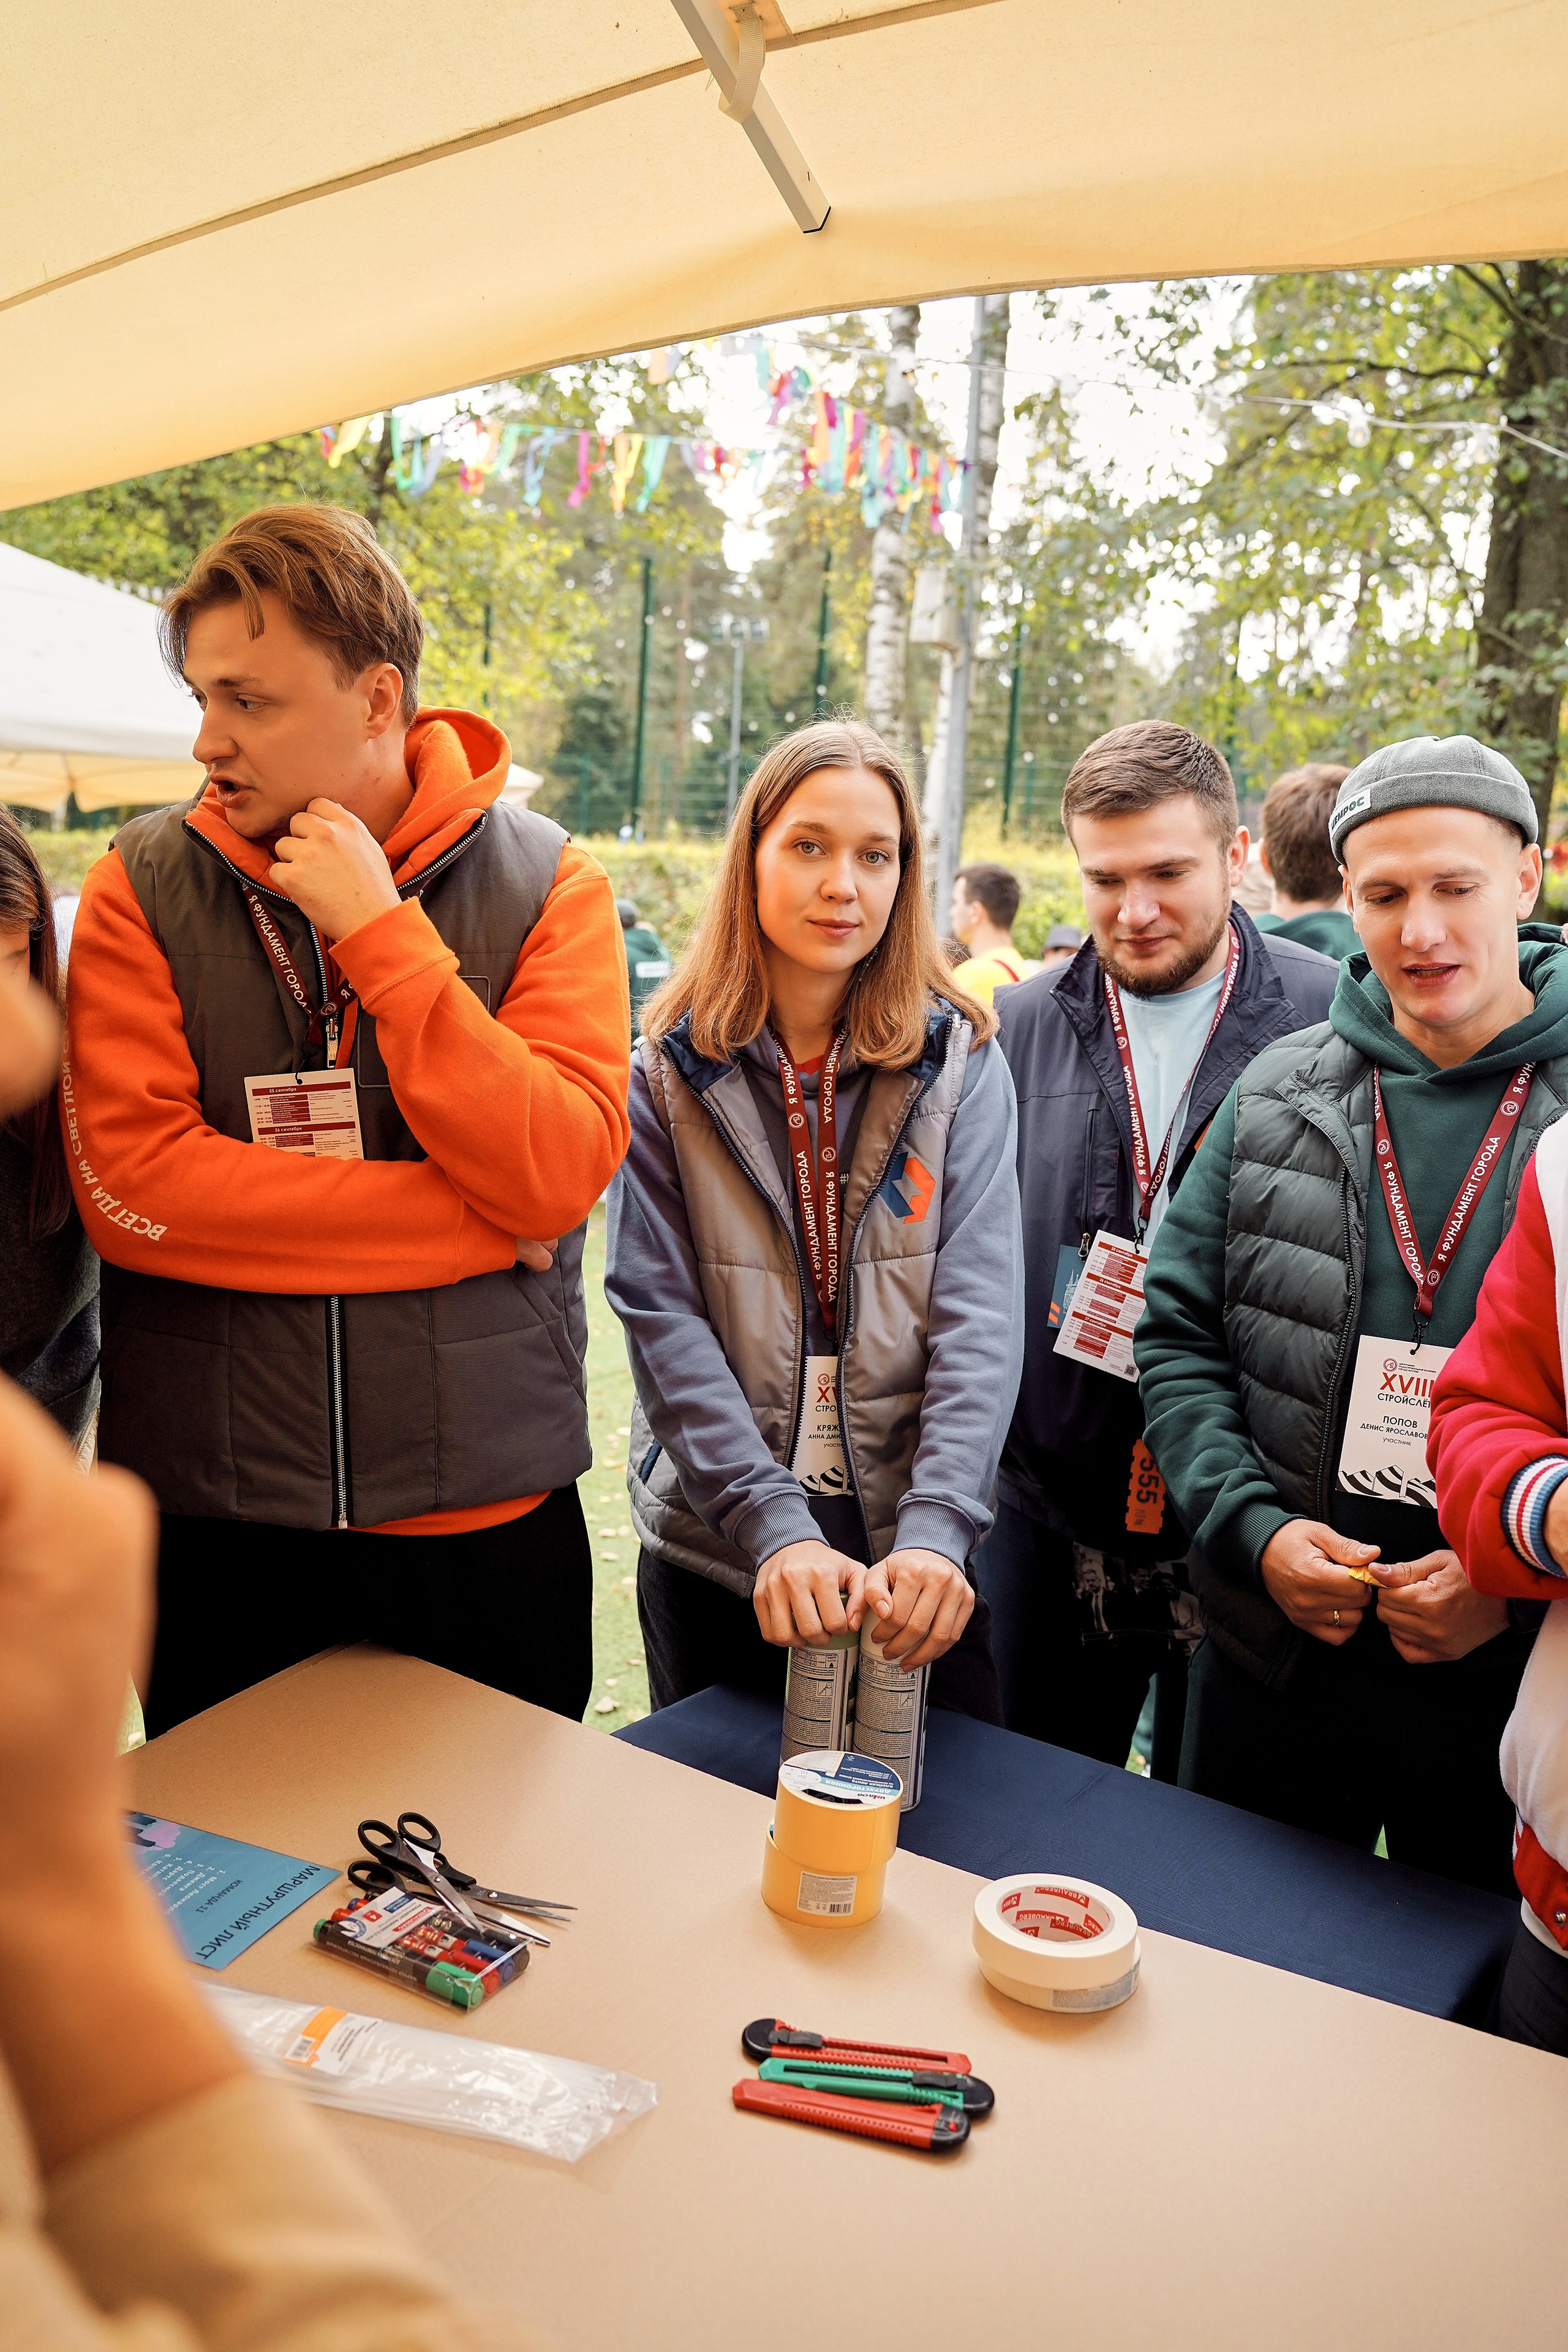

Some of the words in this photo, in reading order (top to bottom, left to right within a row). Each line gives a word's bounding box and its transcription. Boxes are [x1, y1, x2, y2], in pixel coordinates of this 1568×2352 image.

[249, 895, 257, 905] Я
[253, 903, 291, 966] ФУНДАМЕНТ
[1219, 960, 1238, 1014] ФУНДАМЕНТ
[823, 1076, 833, 1124] ГОРОДА
[78, 1159, 99, 1185] НА
[797, 1150, 812, 1199] ГОРОДА
[1383, 1161, 1393, 1170] Я
[1470, 1136, 1501, 1183] ГОРОДА
[1148, 1156, 1167, 1196] ГОРОДА
[91, 1186, 168, 1242] ВСЕГДА
[826, 1180, 837, 1251] ФУНДАМЕНТ
[1385, 1171, 1412, 1239] ФУНДАМЕНТ
[1442, 1182, 1479, 1251] ФУНДАМЕНТ
[804, 1202, 822, 1271] ФУНДАМЕНТ
[1438, 1253, 1447, 1262] Я
[827, 1254, 838, 1302] ГОРОДА
[1379, 1372, 1434, 1398] XVIII
[1360, 1423, 1384, 1432] ДЕНИС
[1382, 1415, 1418, 1428] ПОПОВ
[1383, 1437, 1412, 1446] участник
[825, 1779, 891, 1793] ДВУХСТОРОННЯЯ
[162, 1865, 183, 1881] Дартс
[179, 1872, 206, 1891] Дженга
[198, 1875, 217, 1889] Мост
[205, 1879, 243, 1906] КОМАНДА
[230, 1865, 320, 1931] МАРШРУТНЫЙ
[1055, 1918, 1091, 1937] BRAUBERG
[196, 1929, 235, 1960] ЛИСТ
